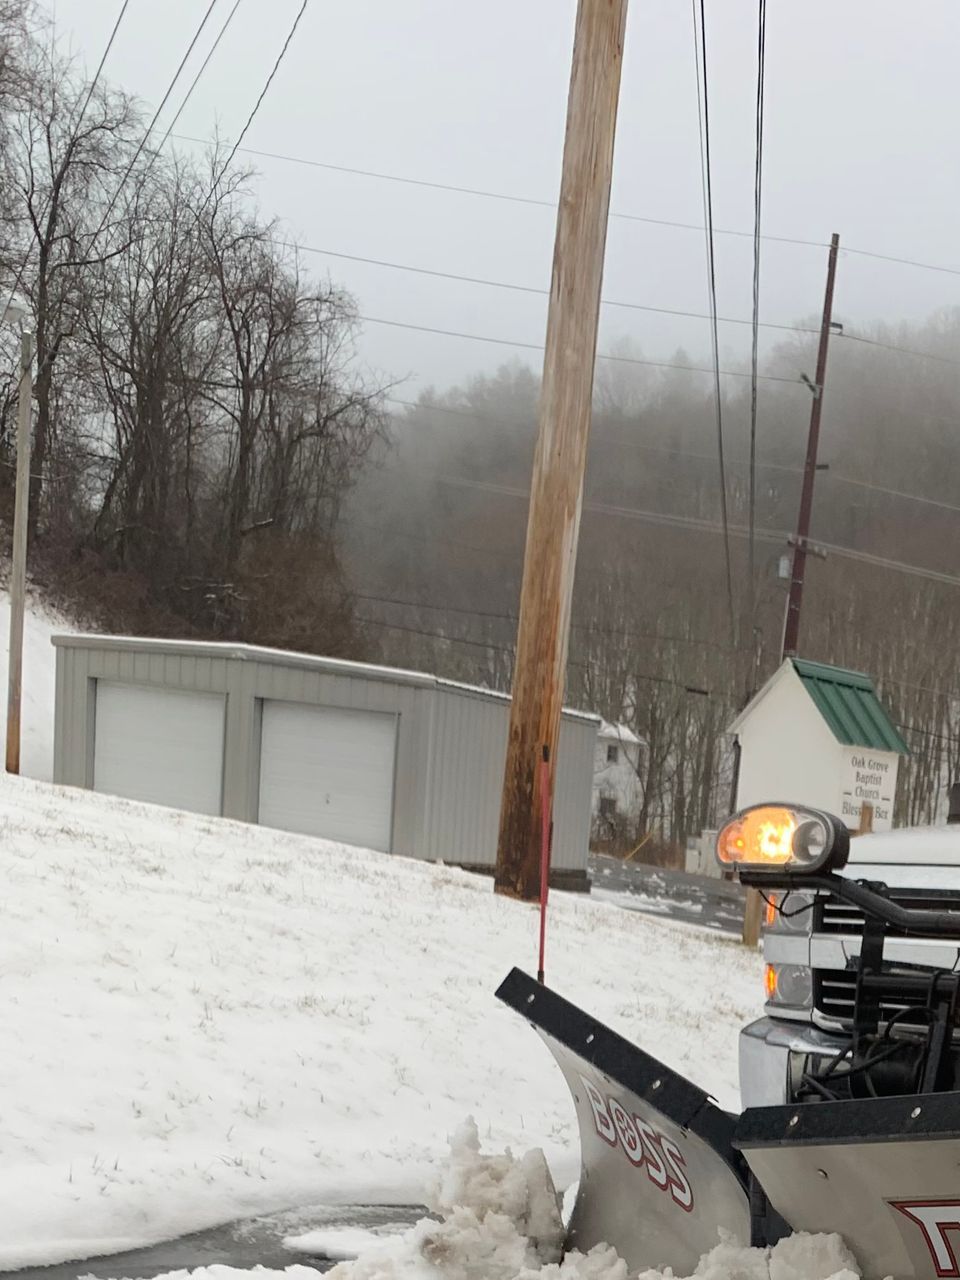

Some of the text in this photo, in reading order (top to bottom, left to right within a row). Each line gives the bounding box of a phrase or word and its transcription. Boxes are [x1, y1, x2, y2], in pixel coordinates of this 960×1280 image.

[851, 755, 889, 773] Oak Grove
[856, 771, 882, 786] Baptist
[855, 786, 880, 800] Church
[578, 1073, 694, 1212] BOSS
